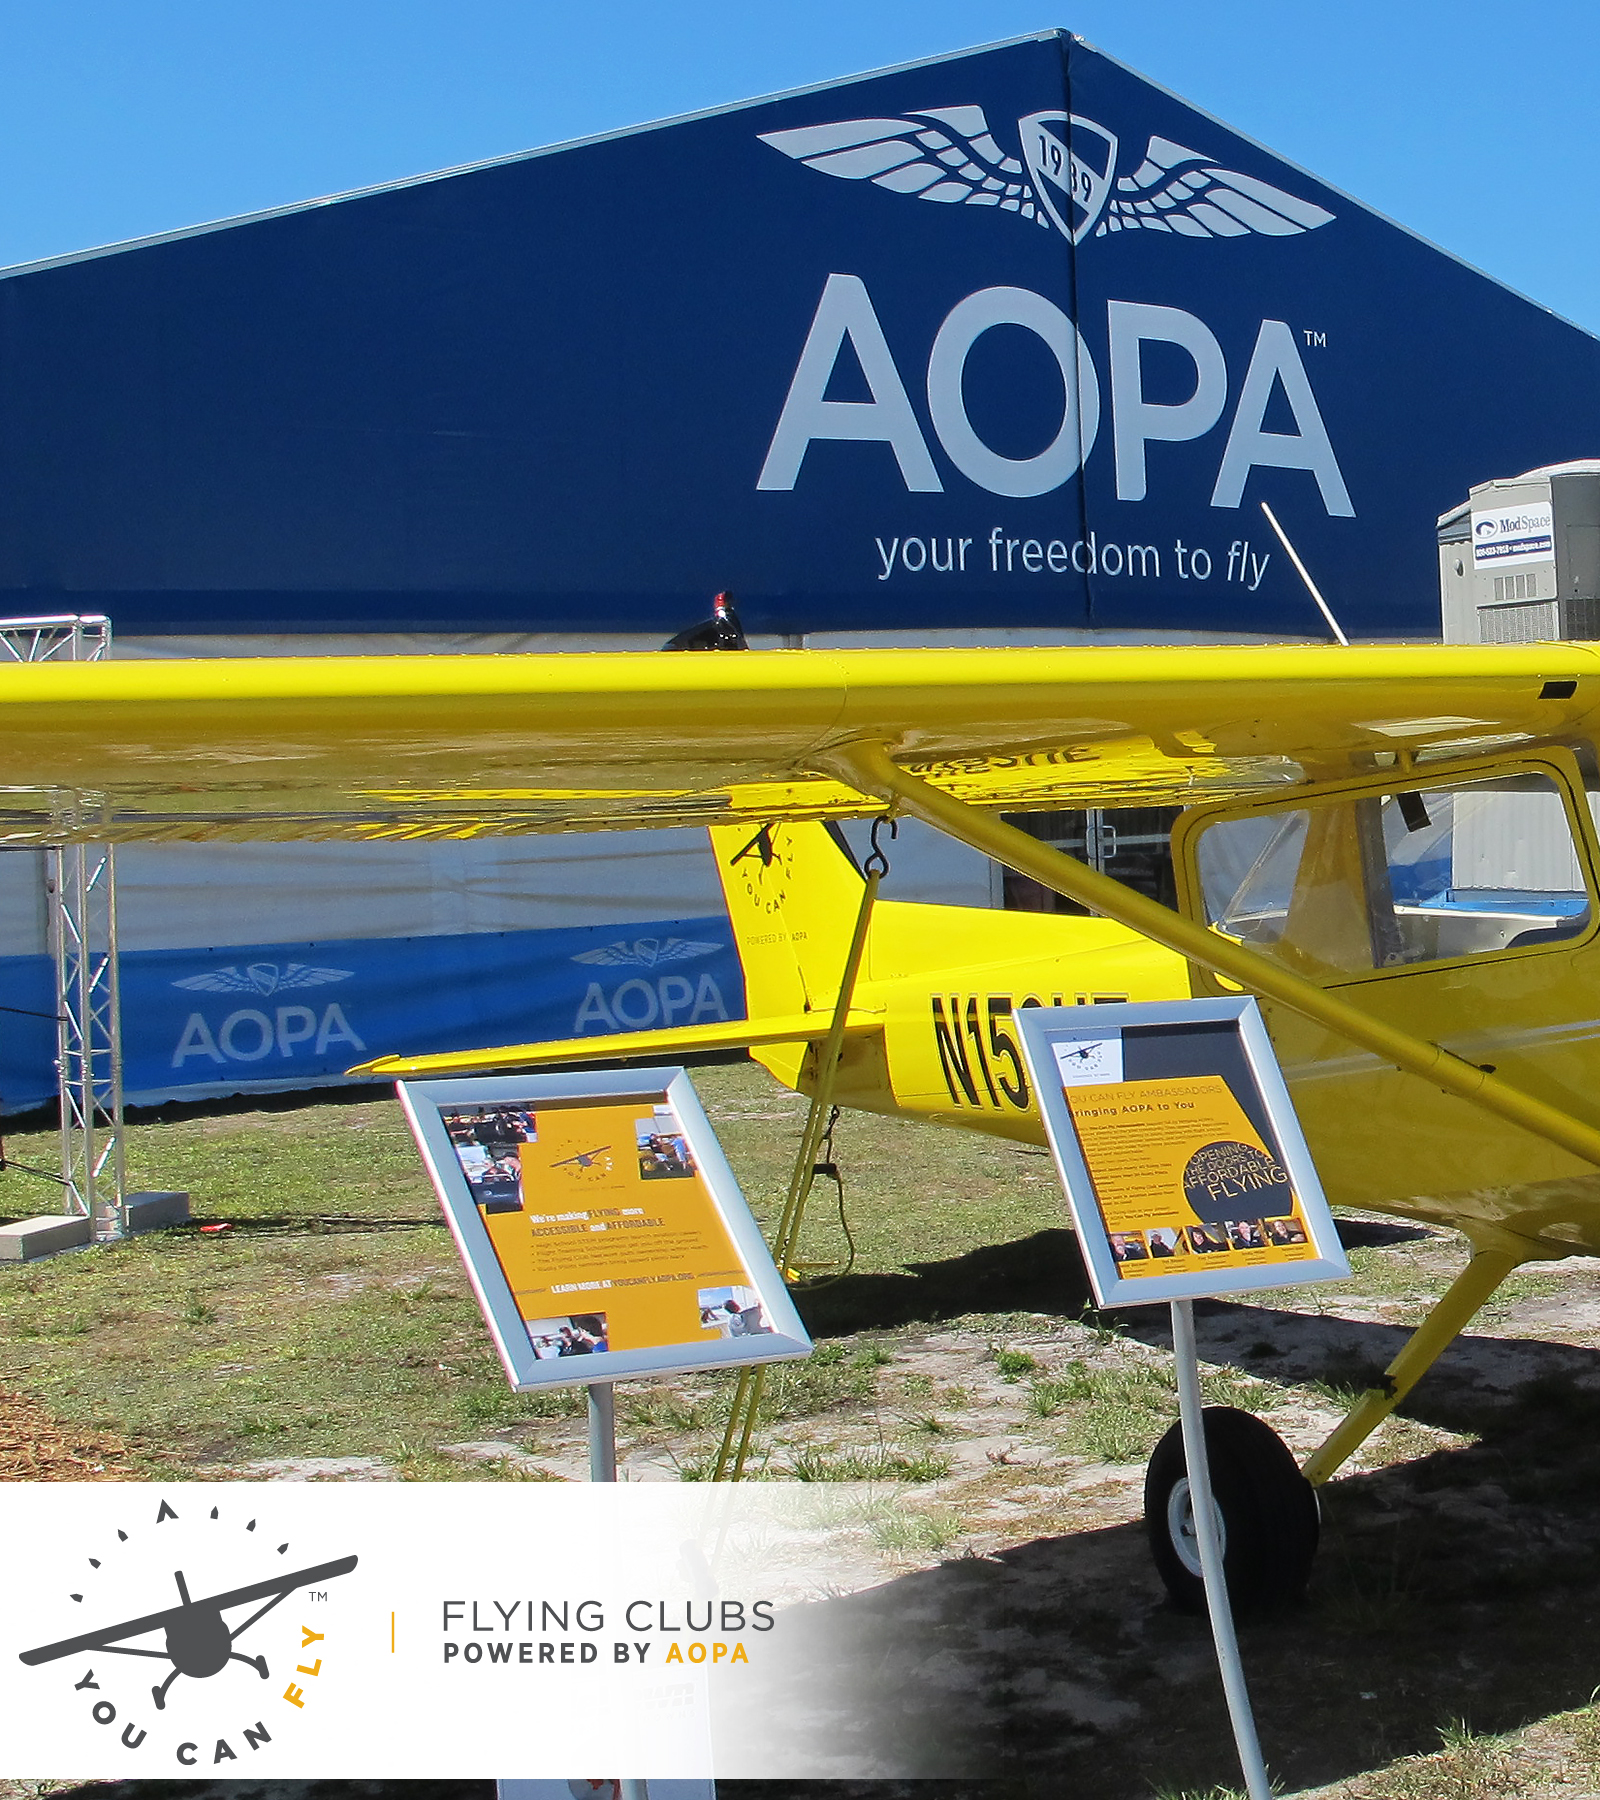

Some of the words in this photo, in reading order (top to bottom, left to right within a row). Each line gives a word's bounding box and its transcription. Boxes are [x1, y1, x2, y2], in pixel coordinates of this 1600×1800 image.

[756, 272, 1357, 518] AOPA
[1500, 515, 1551, 533] ModSpace
[875, 535, 973, 581] your
[988, 526, 1160, 578] freedom
[1175, 538, 1212, 580] to
[1226, 540, 1270, 592] fly
[765, 890, 787, 914] CAN
[573, 974, 729, 1034] AOPA
[171, 1002, 367, 1068] AOPA
[931, 993, 1128, 1111] N15
[1069, 1094, 1087, 1104] OU
[1090, 1093, 1115, 1103] CAN
[1117, 1091, 1136, 1101] FLY
[1140, 1085, 1223, 1099] AMBASSADORS
[1121, 1103, 1154, 1114] AOPA
[1158, 1103, 1170, 1111] to
[1174, 1101, 1196, 1110] You
[1190, 1143, 1248, 1166] OPENING
[1206, 1152, 1248, 1171] DOORS
[1206, 1165, 1289, 1202] FLYING
